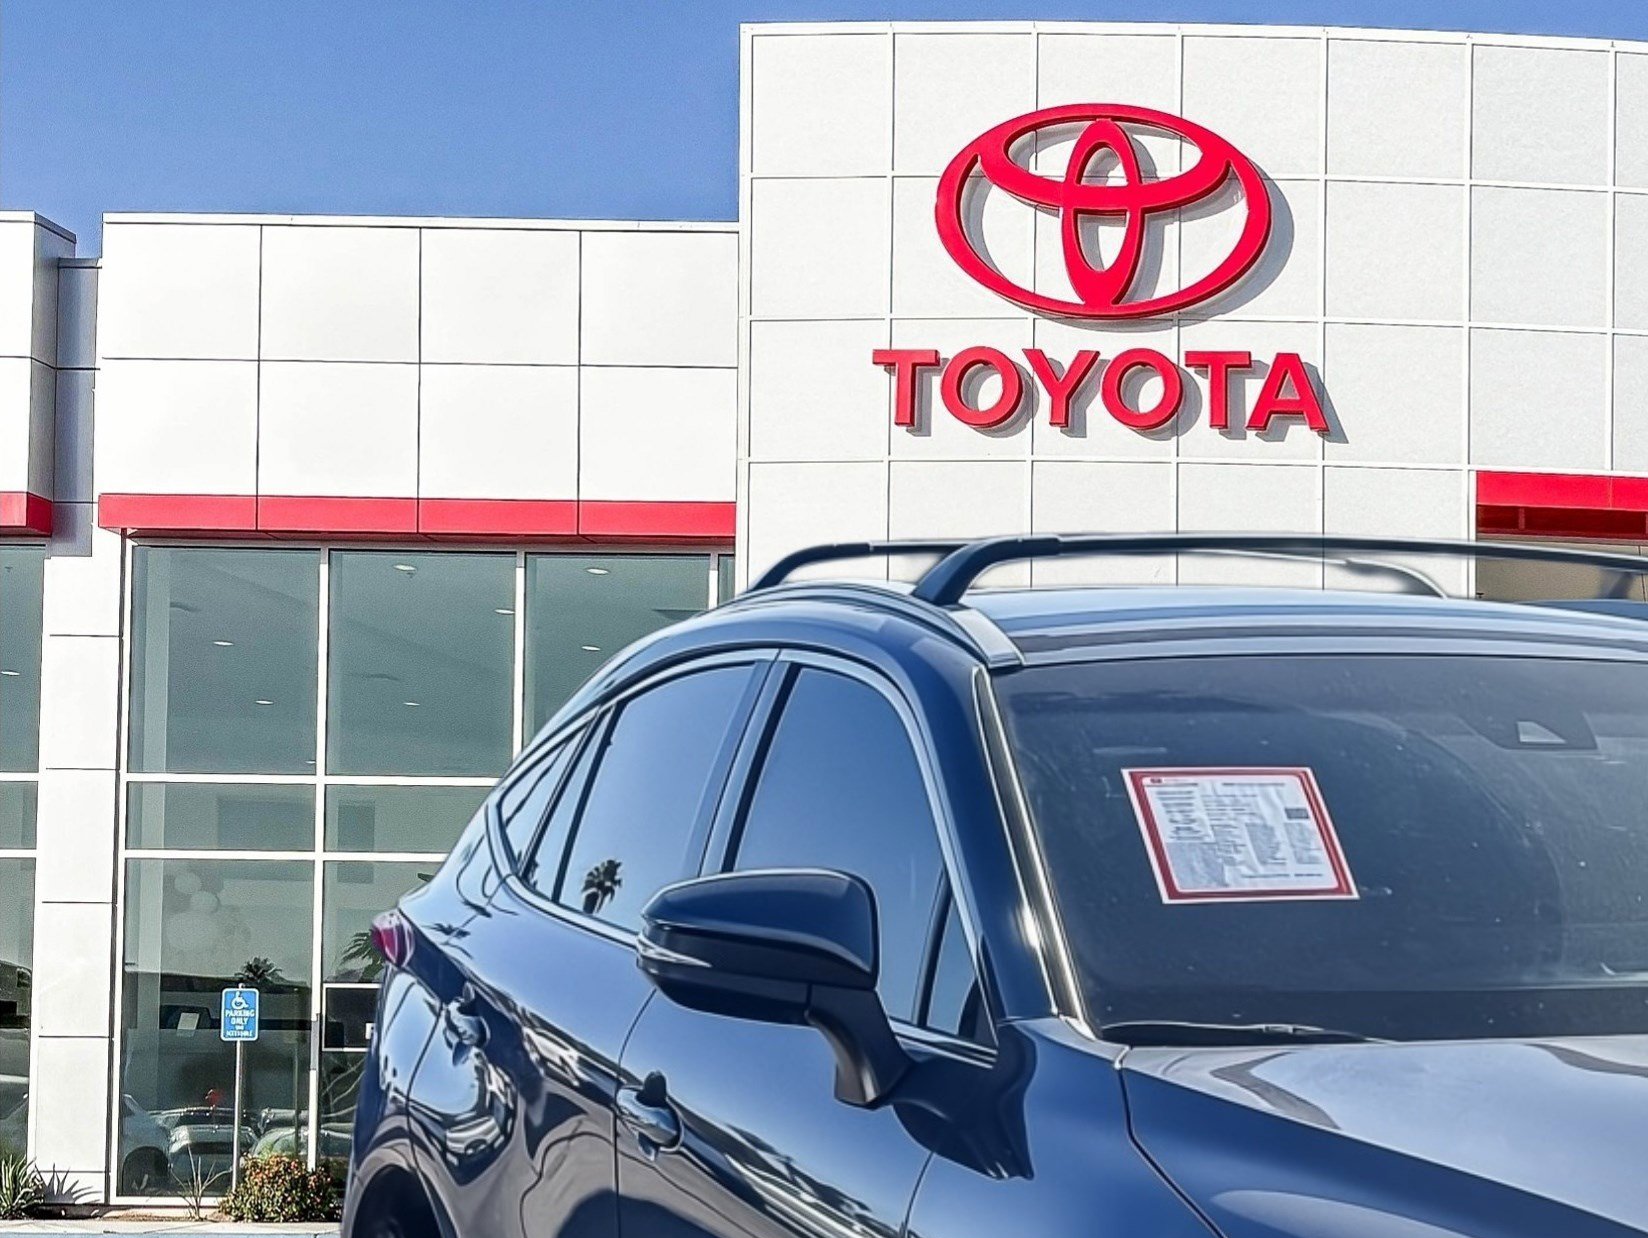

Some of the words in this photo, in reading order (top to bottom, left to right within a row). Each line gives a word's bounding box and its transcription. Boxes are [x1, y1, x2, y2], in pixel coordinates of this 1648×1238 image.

[872, 345, 1330, 433] TOYOTA
[225, 1009, 255, 1018] PARKING
[230, 1017, 249, 1025] ONLY
